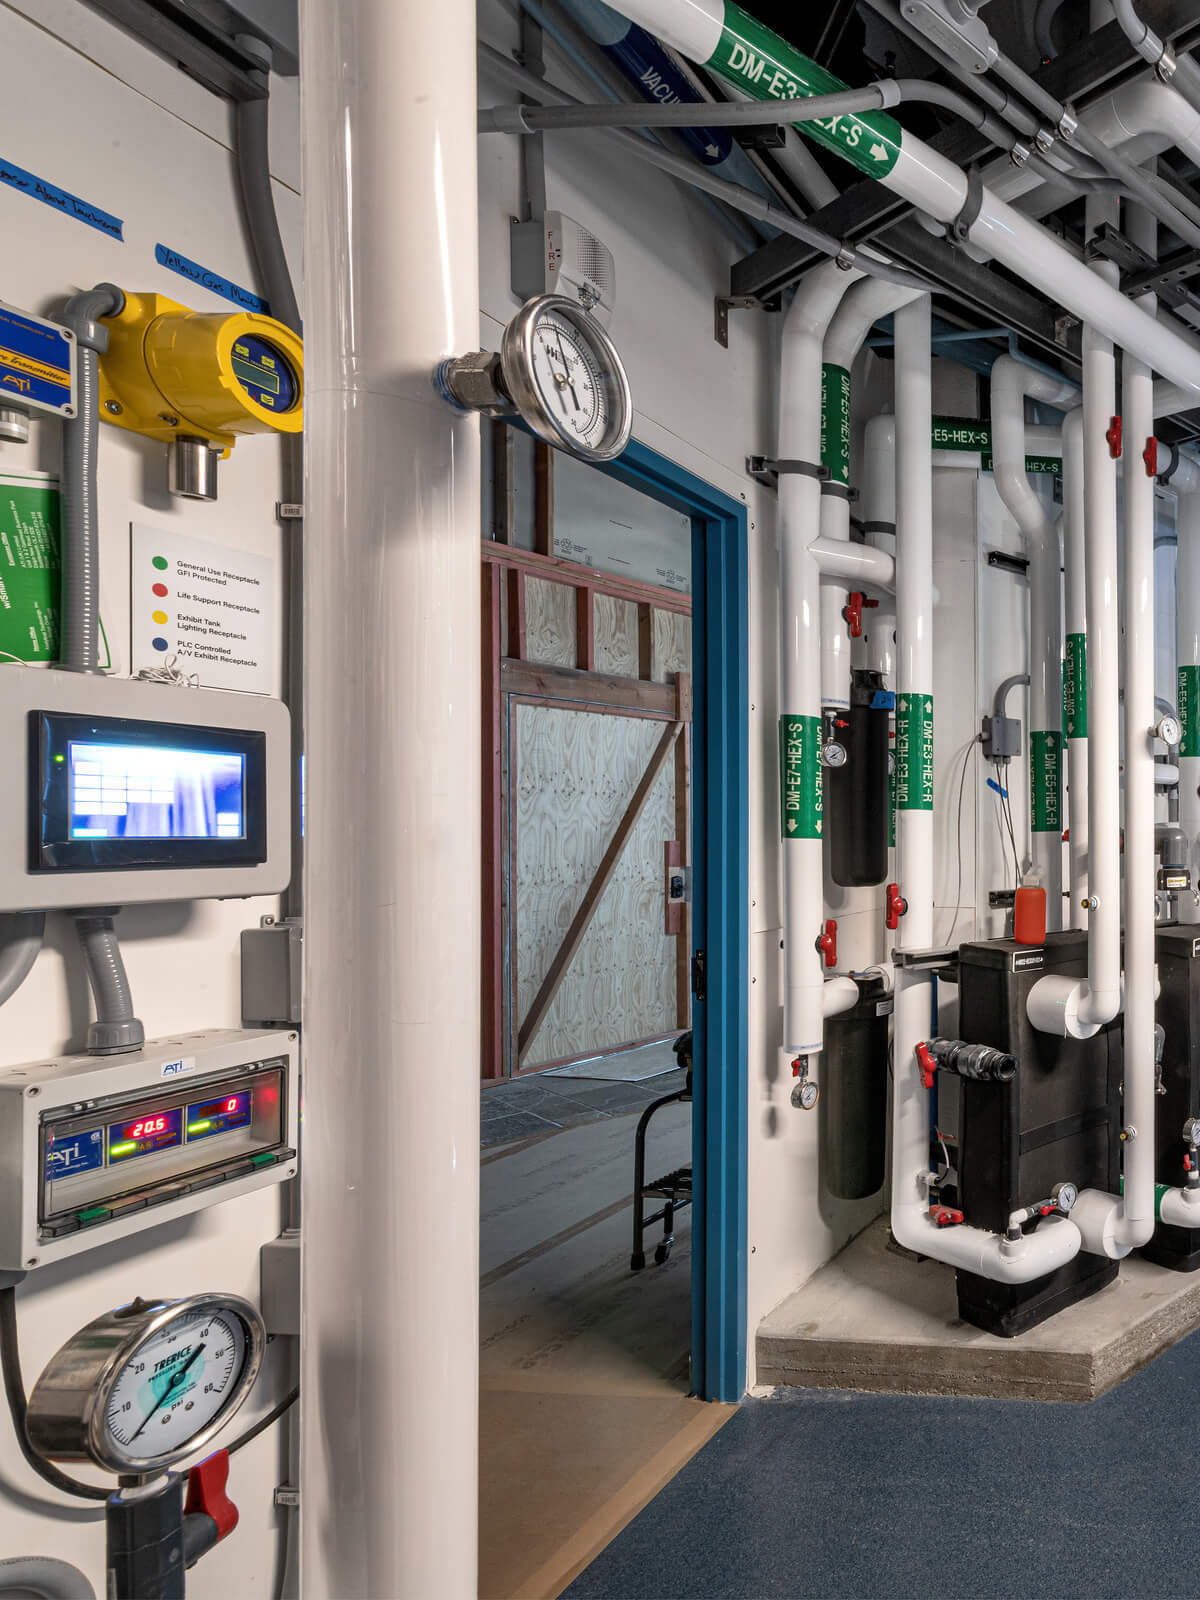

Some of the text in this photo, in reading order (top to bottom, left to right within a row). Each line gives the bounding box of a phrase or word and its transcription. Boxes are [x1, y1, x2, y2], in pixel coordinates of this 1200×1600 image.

[547, 231, 556, 271] FIRE
[177, 561, 260, 585] General Use Receptacle
[177, 569, 227, 586] GFI Protected
[177, 592, 260, 614] Life Support Receptacle
[177, 614, 221, 627] Exhibit Tank
[177, 622, 247, 640] Lighting Receptacle
[177, 649, 257, 667] A/V Exhibit Receptacle
[194, 643, 231, 655] Controlled
[787, 722, 803, 811] DM-E7-HEX-S
[897, 719, 909, 802] DM-E3-HEX-R
[923, 720, 933, 802] DM-E3-HEX-R
[1045, 753, 1057, 825] DM-E5-HEX-R
[228, 1099, 238, 1112] 0
[133, 1118, 165, 1137] 20.5
[200, 1329, 209, 1339] 40
[153, 1344, 192, 1374] TRERICE
[134, 1362, 145, 1375] 20
[204, 1382, 214, 1394] 60
[122, 1400, 132, 1412] 10
